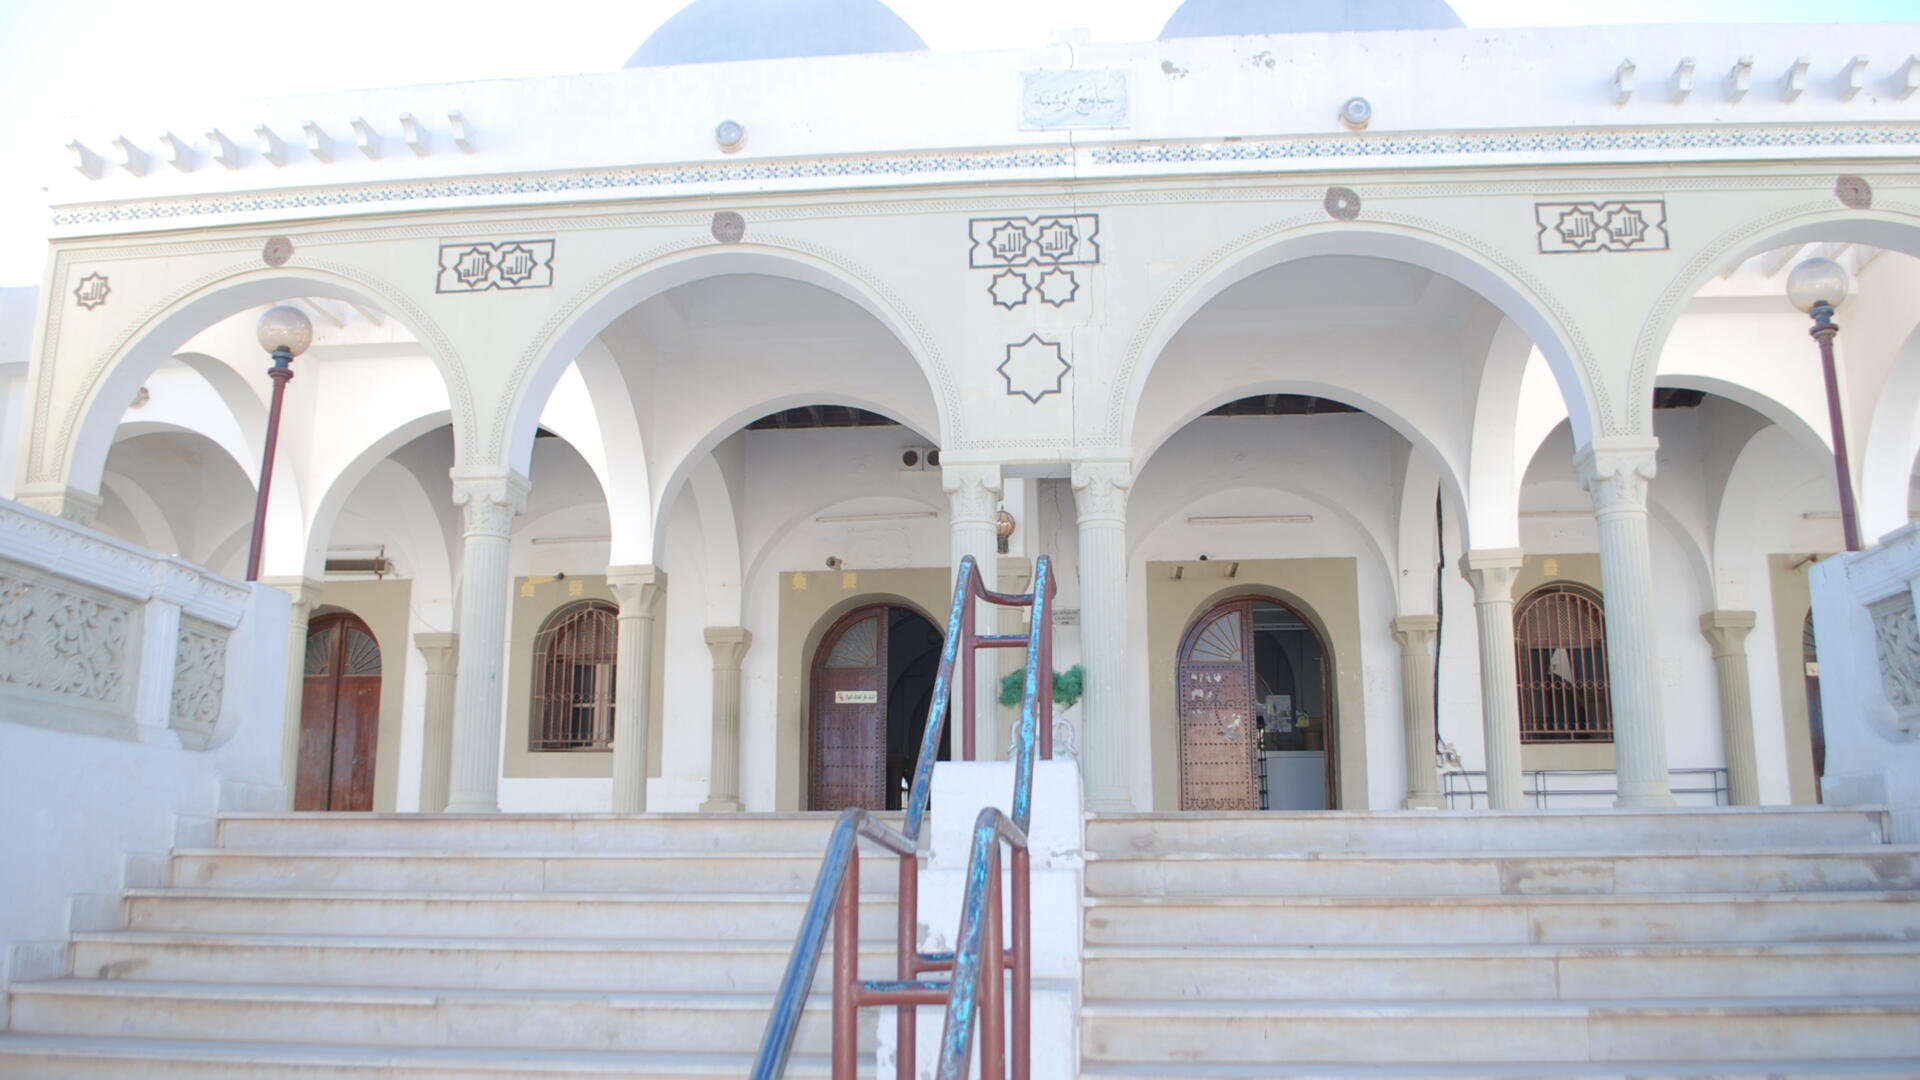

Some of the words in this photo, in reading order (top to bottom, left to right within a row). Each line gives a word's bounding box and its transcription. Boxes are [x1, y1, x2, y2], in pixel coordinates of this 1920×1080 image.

[1076, 82, 1115, 115] جامع
[1566, 217, 1590, 237] الله
[1615, 216, 1638, 236] الله
[998, 232, 1021, 252] الله
[1045, 231, 1068, 251] الله
[463, 257, 485, 277] الله
[506, 255, 528, 275] الله
